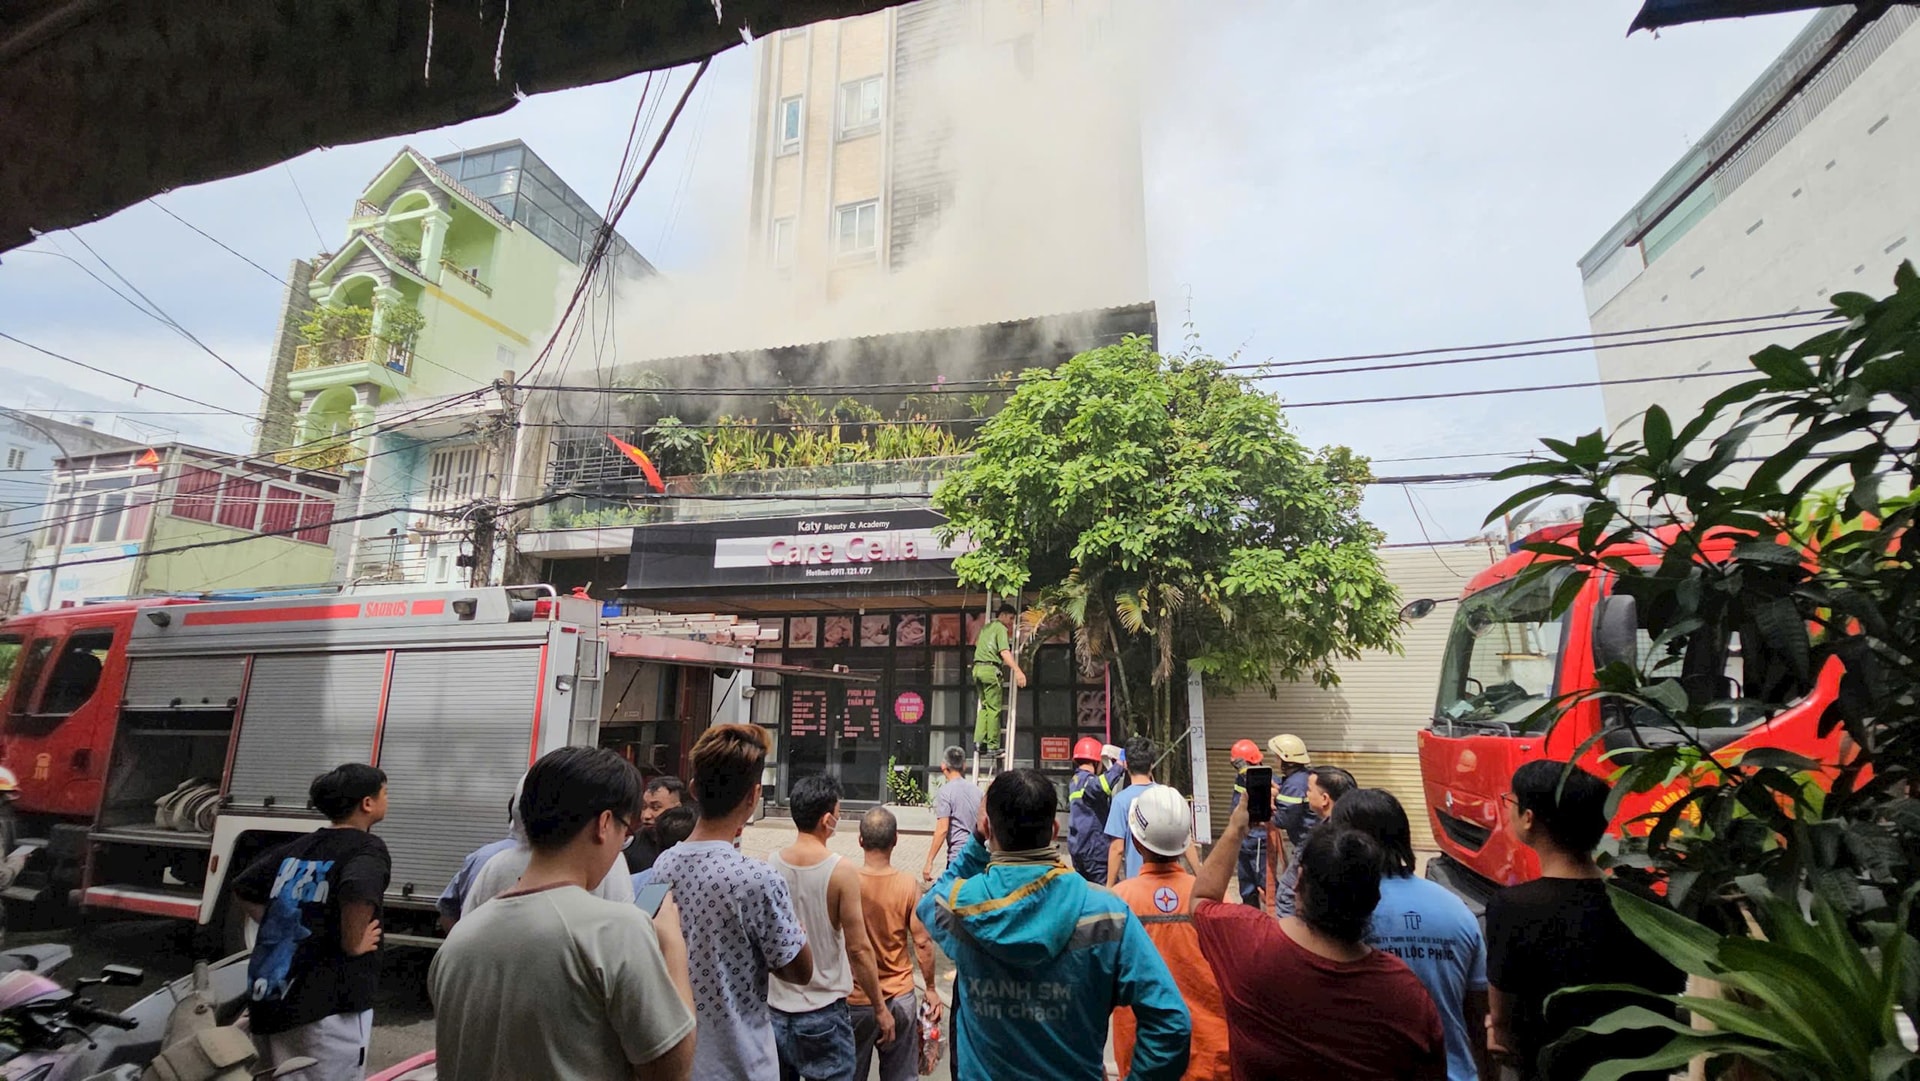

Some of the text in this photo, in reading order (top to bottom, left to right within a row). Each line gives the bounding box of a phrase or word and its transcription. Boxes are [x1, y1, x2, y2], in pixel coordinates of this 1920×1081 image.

[797, 521, 822, 534] Katy
[824, 523, 848, 531] Beauty
[858, 521, 890, 529] Academy
[767, 532, 919, 565] Care Cella
[365, 600, 408, 618] SAURUS
[1405, 945, 1425, 960] LỘC
[968, 977, 1072, 1000] XANH SM
